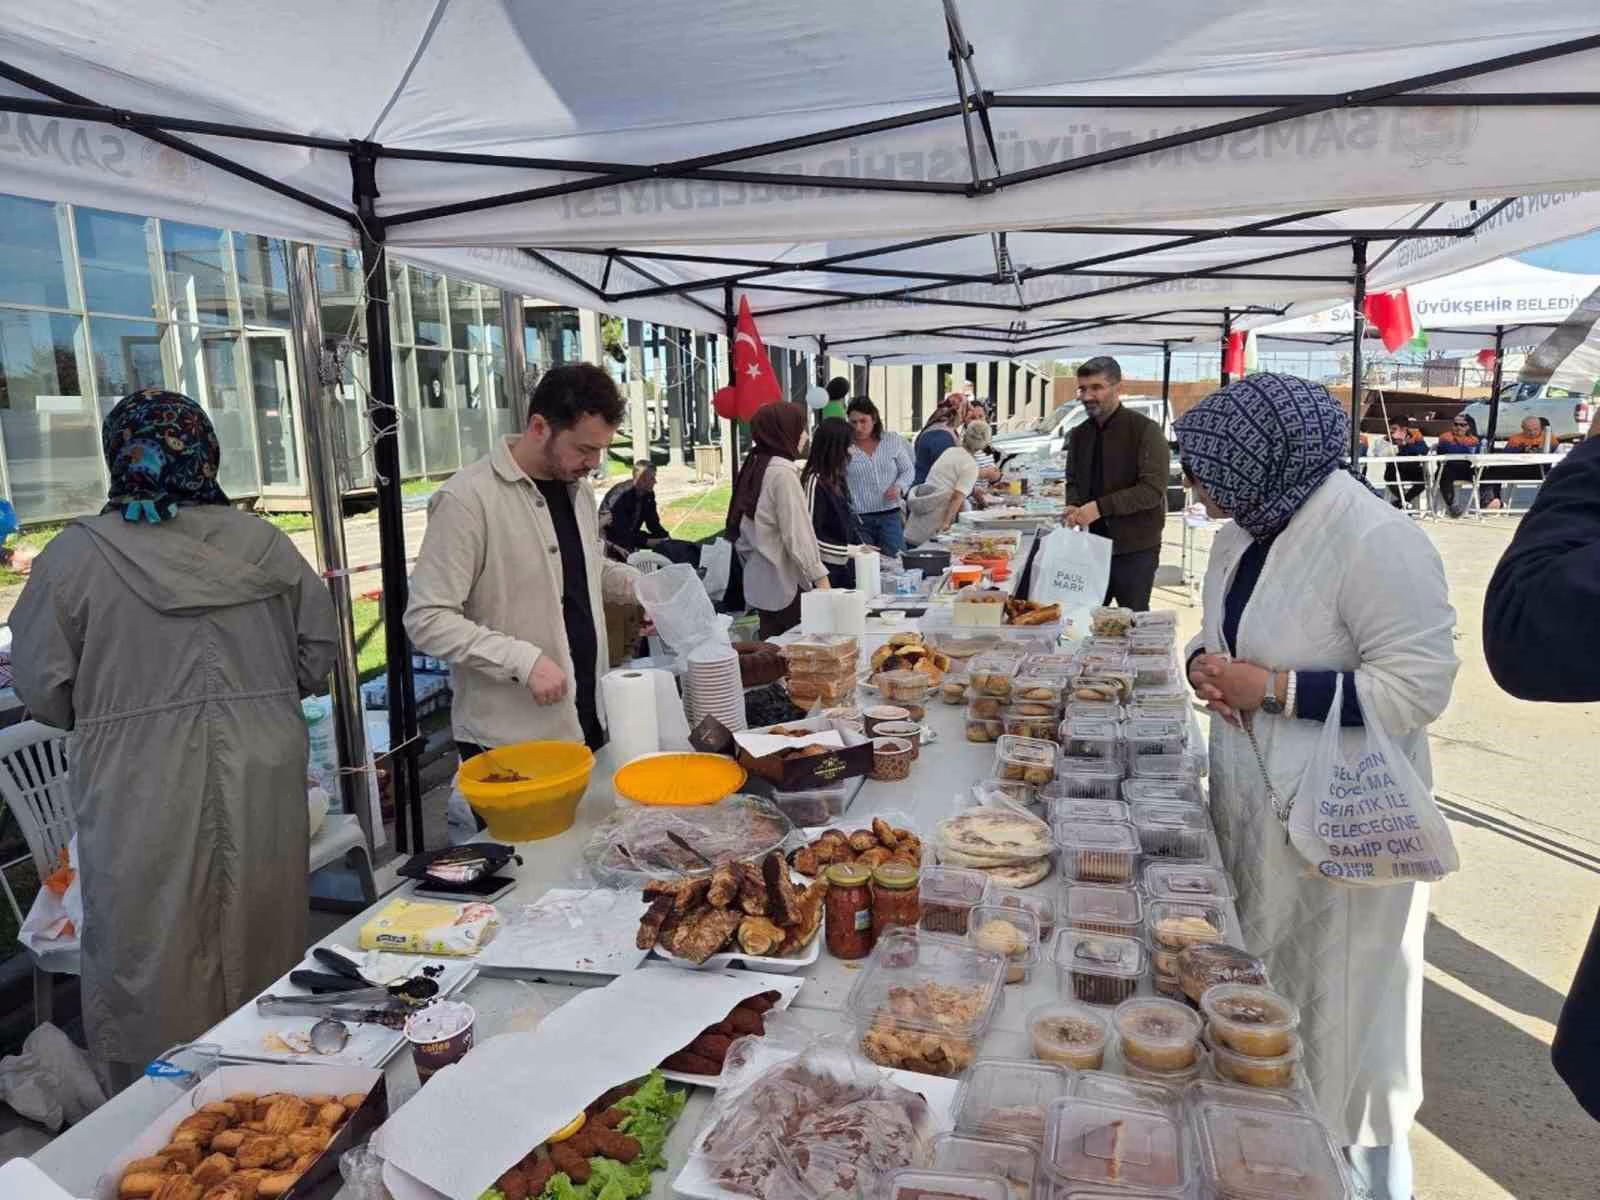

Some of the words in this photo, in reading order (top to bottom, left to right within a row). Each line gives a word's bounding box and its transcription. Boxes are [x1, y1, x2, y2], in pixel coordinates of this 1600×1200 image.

[1416, 297, 1512, 315] ÜYÜKŞEHİR
[1056, 570, 1086, 583] PAUL
[1053, 580, 1086, 592] MARK
[1318, 814, 1420, 838] GELECEĞİNE
[1328, 839, 1382, 857] SAHİP
